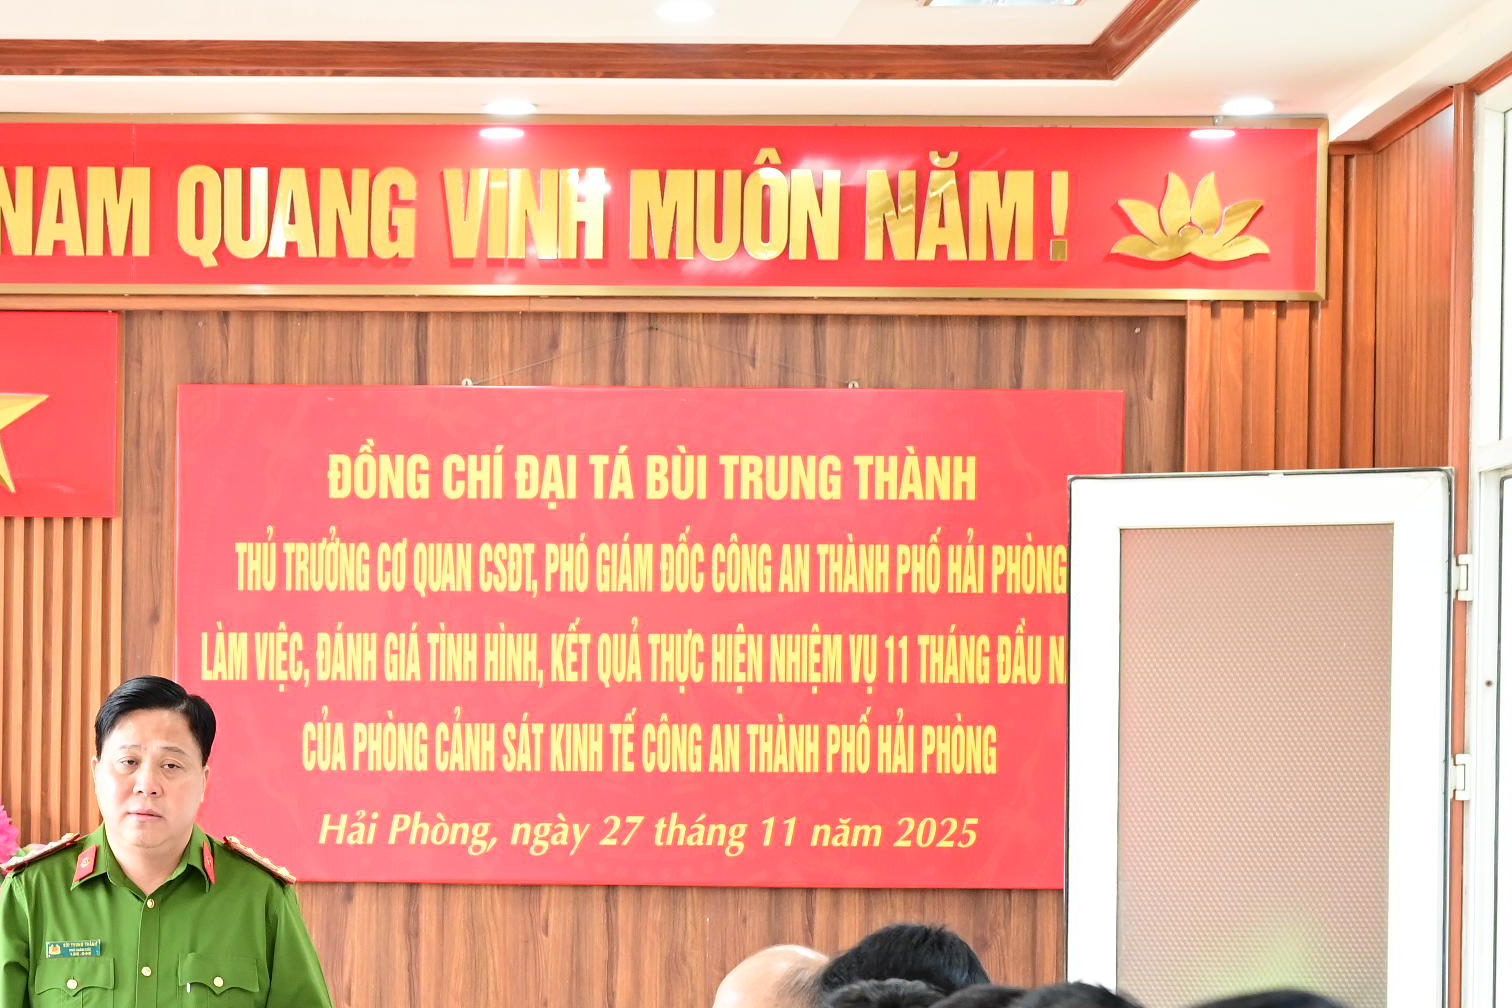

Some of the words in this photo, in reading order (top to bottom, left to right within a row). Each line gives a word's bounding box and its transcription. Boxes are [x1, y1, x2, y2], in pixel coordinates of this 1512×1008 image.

[177, 165, 417, 267] QUANG
[443, 168, 606, 259] VINH
[629, 148, 841, 261] MUÔN
[327, 438, 429, 500] ĐỒNG
[443, 445, 504, 500] CHÍ
[515, 455, 576, 511] ĐẠI
[589, 445, 634, 500] TÁ
[646, 445, 707, 501] BÙI
[719, 455, 842, 501] TRUNG
[854, 446, 977, 501] THÀNH
[235, 525, 277, 592] THỦ
[283, 525, 370, 593] TRƯỞNG
[377, 537, 408, 593] CƠ
[413, 541, 472, 598] QUAN
[478, 542, 538, 599] CSĐT,
[545, 531, 589, 593] PHÓ
[596, 532, 653, 593] GIÁM
[660, 524, 705, 593] ĐỐC
[712, 532, 772, 593] CÔNG
[779, 543, 810, 593] AN
[817, 532, 890, 593] THÀNH
[897, 526, 941, 594] PHỐ
[948, 527, 984, 594] HẢI
[992, 532, 1069, 594] PHÒNG
[200, 620, 248, 681] LÀM
[254, 622, 310, 693] VIỆC,
[316, 622, 378, 682] ĐÁNH
[383, 622, 422, 682] GIÁ
[427, 622, 478, 682] TÌNH
[484, 622, 543, 688] HÌNH,
[550, 616, 592, 683] KẾT
[598, 616, 642, 688] QUẢ
[648, 629, 704, 695] THỰC
[711, 623, 763, 695] HIỆN
[770, 623, 842, 695] NHIỆM
[849, 633, 878, 695] VỤ
[885, 634, 908, 684] 11
[918, 623, 990, 684] THÁNG
[997, 617, 1042, 685] ĐẦU
[301, 705, 347, 772] CỦA
[353, 710, 428, 773] PHÒNG
[434, 705, 495, 773] CẢNH
[502, 712, 545, 773] SÁT
[550, 722, 603, 773] KINH
[609, 706, 637, 773] TẾ
[642, 712, 702, 773] CÔNG
[709, 723, 740, 773] AN
[747, 712, 820, 773] THÀNH
[827, 706, 871, 774] PHỐ
[878, 707, 915, 774] HẢI
[922, 712, 997, 774] PHÒNG
[318, 810, 379, 847] Hải
[387, 810, 499, 857] Phòng,
[510, 812, 590, 857] ngày
[600, 815, 644, 846] 27
[654, 812, 747, 857] tháng
[761, 815, 797, 847] 11
[810, 816, 883, 848] năm
[893, 816, 979, 849] 2025
